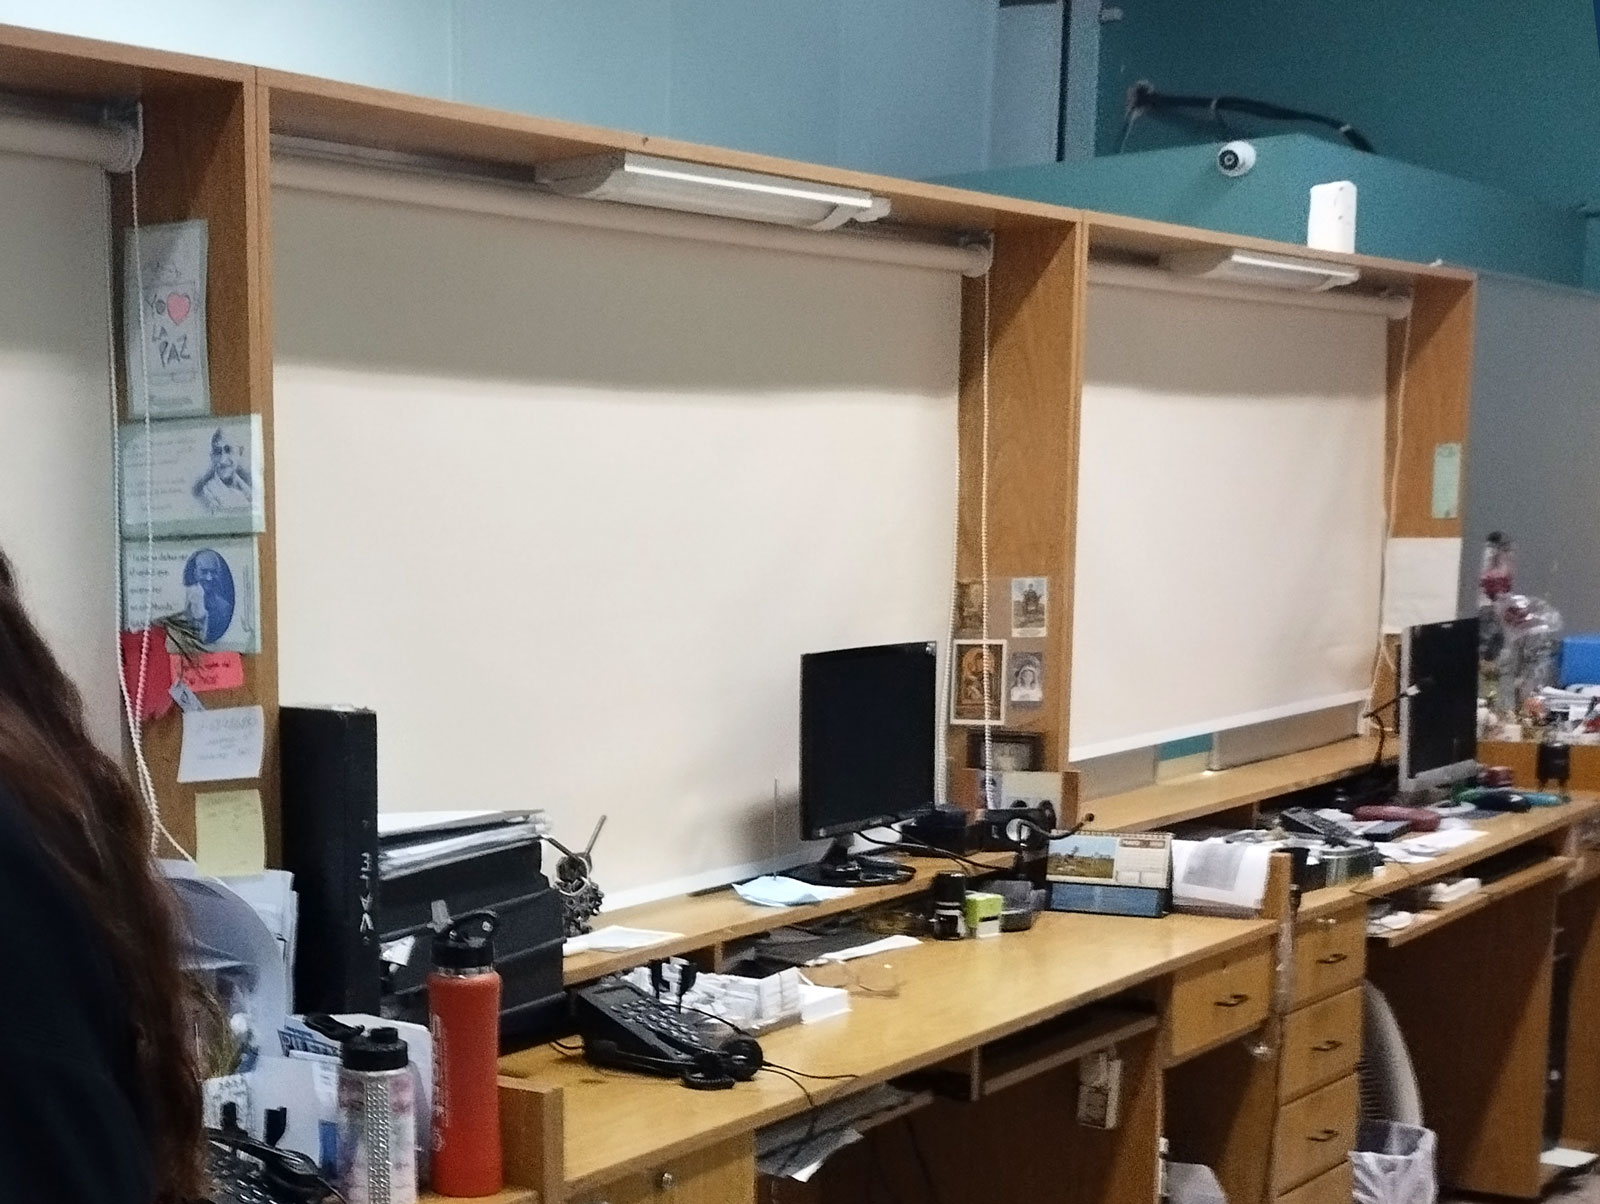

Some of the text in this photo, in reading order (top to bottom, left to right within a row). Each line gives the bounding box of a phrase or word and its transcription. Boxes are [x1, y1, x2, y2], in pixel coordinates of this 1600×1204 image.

[147, 294, 165, 315] YO
[152, 326, 168, 342] LA
[159, 336, 191, 368] PAZ
